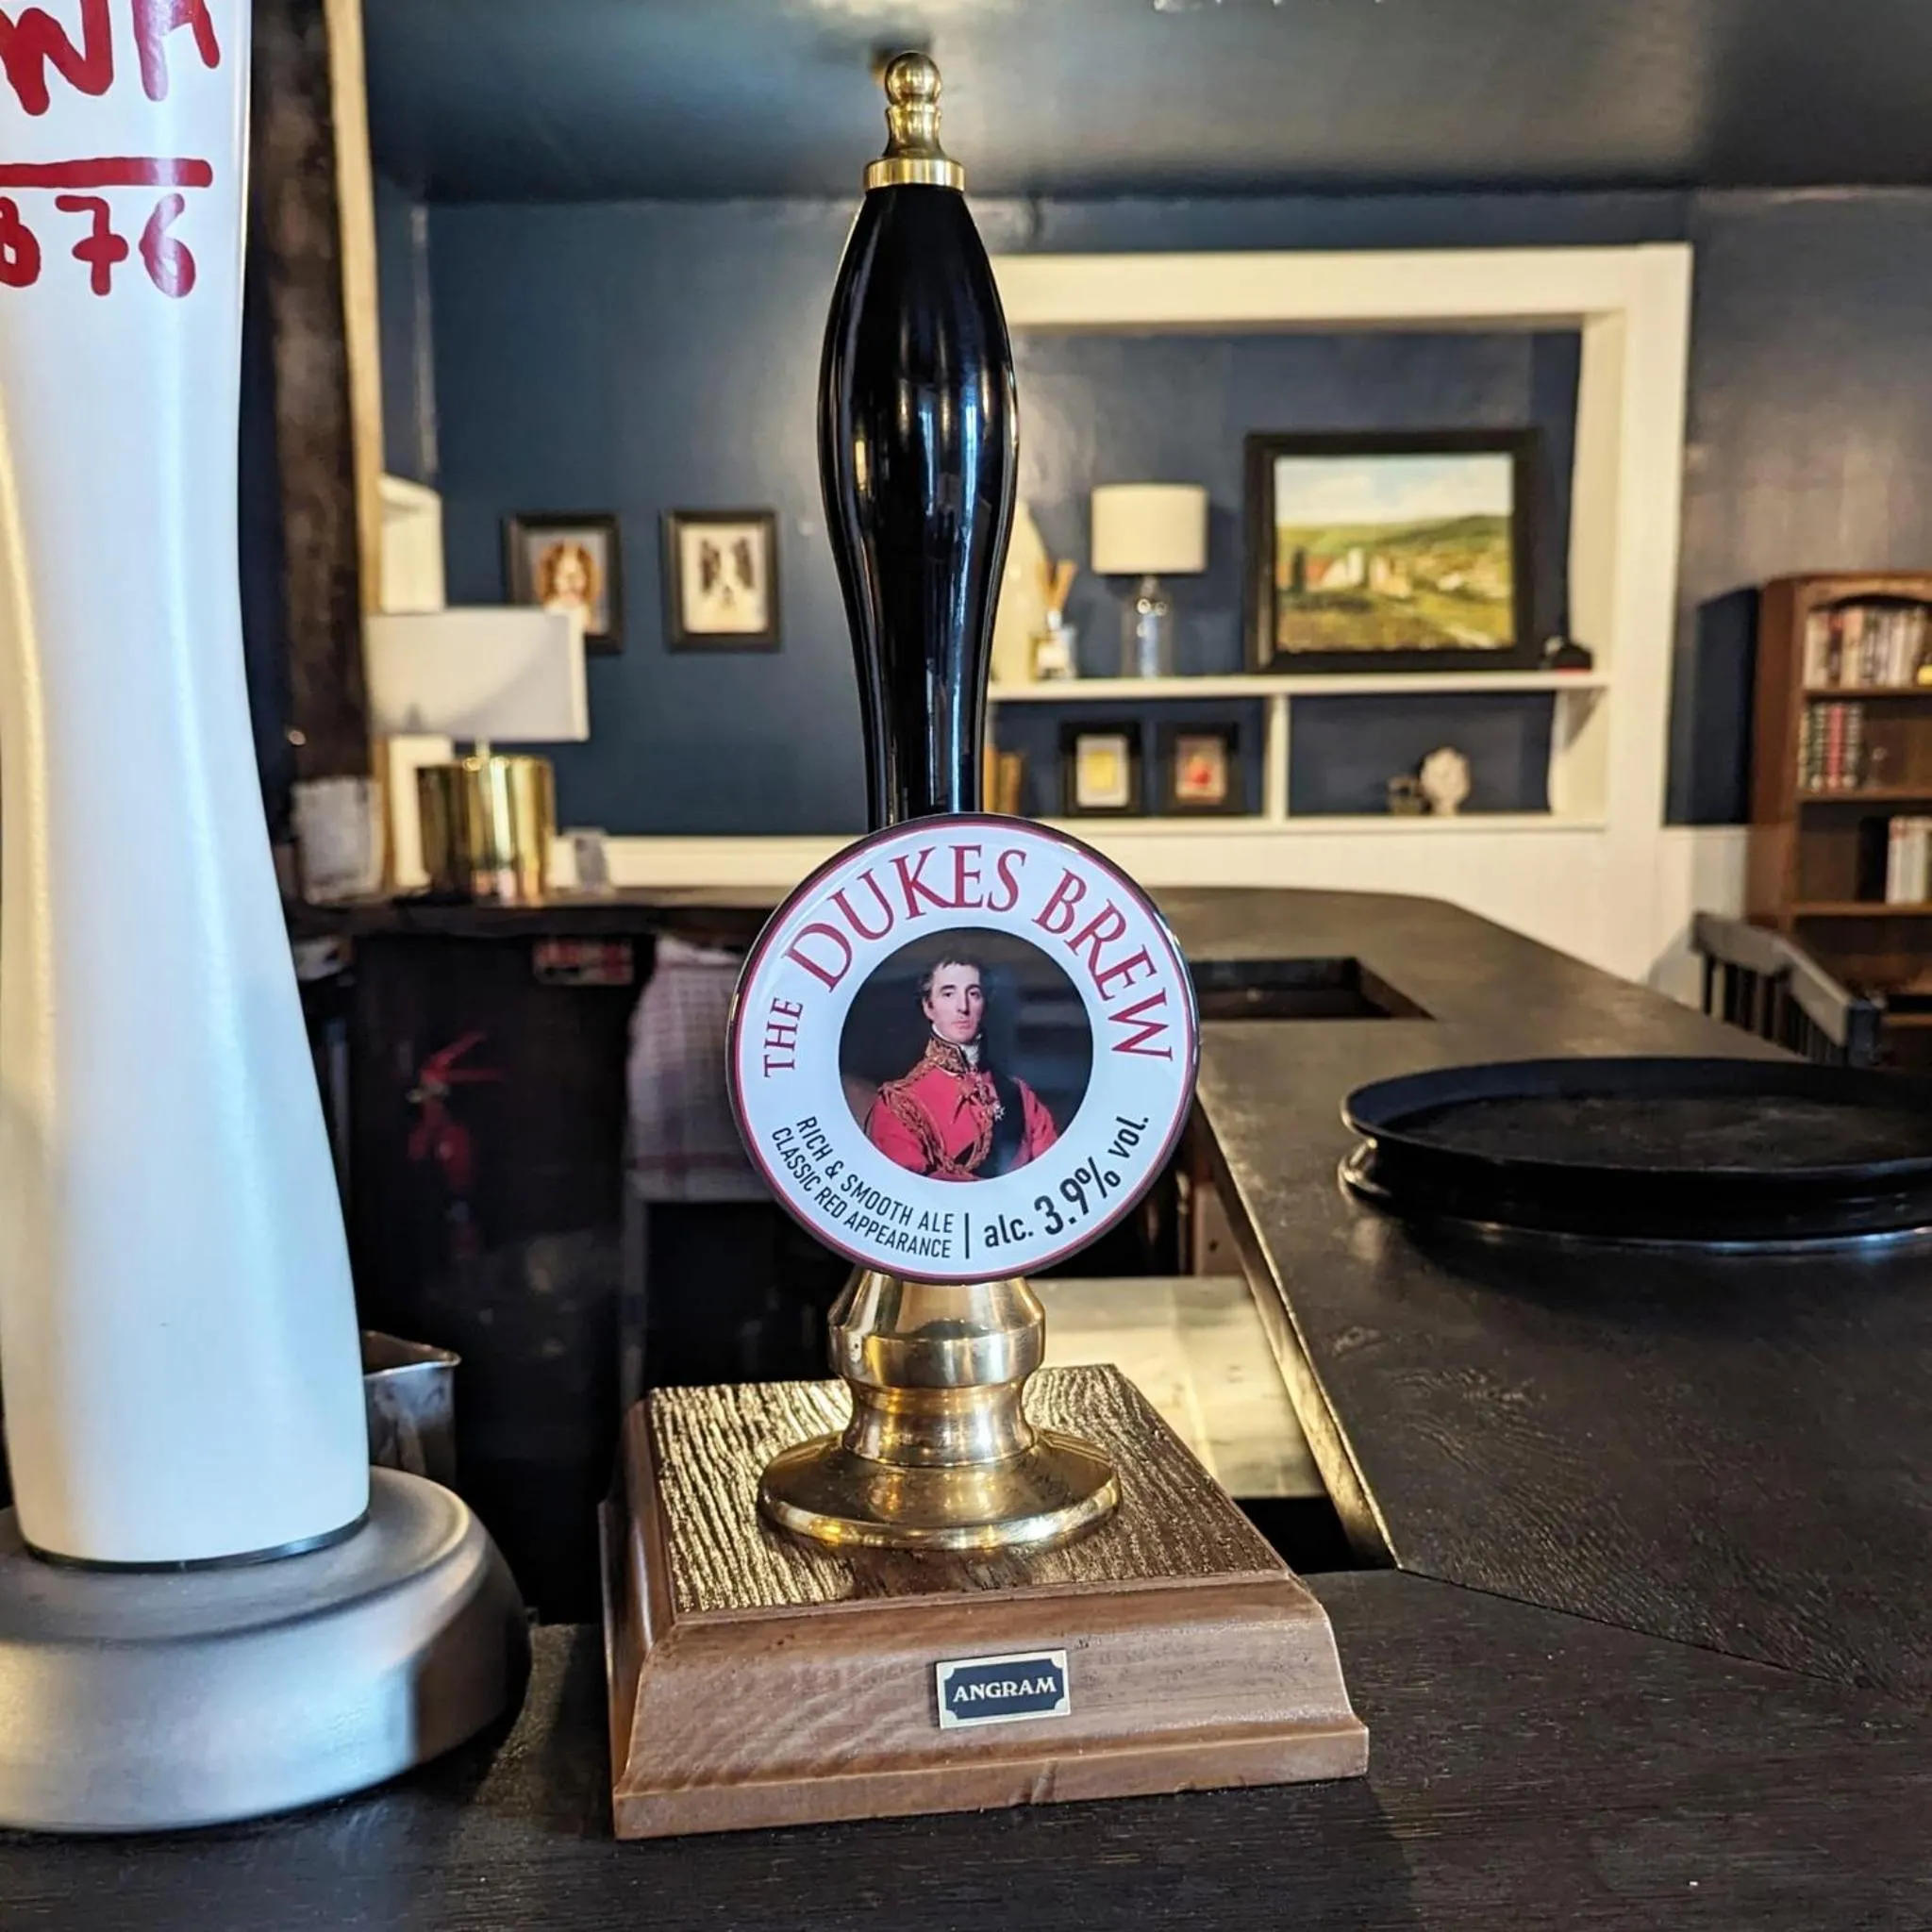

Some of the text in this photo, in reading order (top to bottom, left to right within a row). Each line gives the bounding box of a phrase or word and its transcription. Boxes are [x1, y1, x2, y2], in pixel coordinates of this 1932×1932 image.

[763, 844, 1174, 1078] THE DUKES BREW
[772, 1127, 952, 1258] CLASSIC RED APPEARANCE
[796, 1116, 955, 1234] RICH & SMOOTH ALE
[984, 1116, 1149, 1248] alc. 3.9% vol.
[953, 1676, 1058, 1702] ANGRAM
